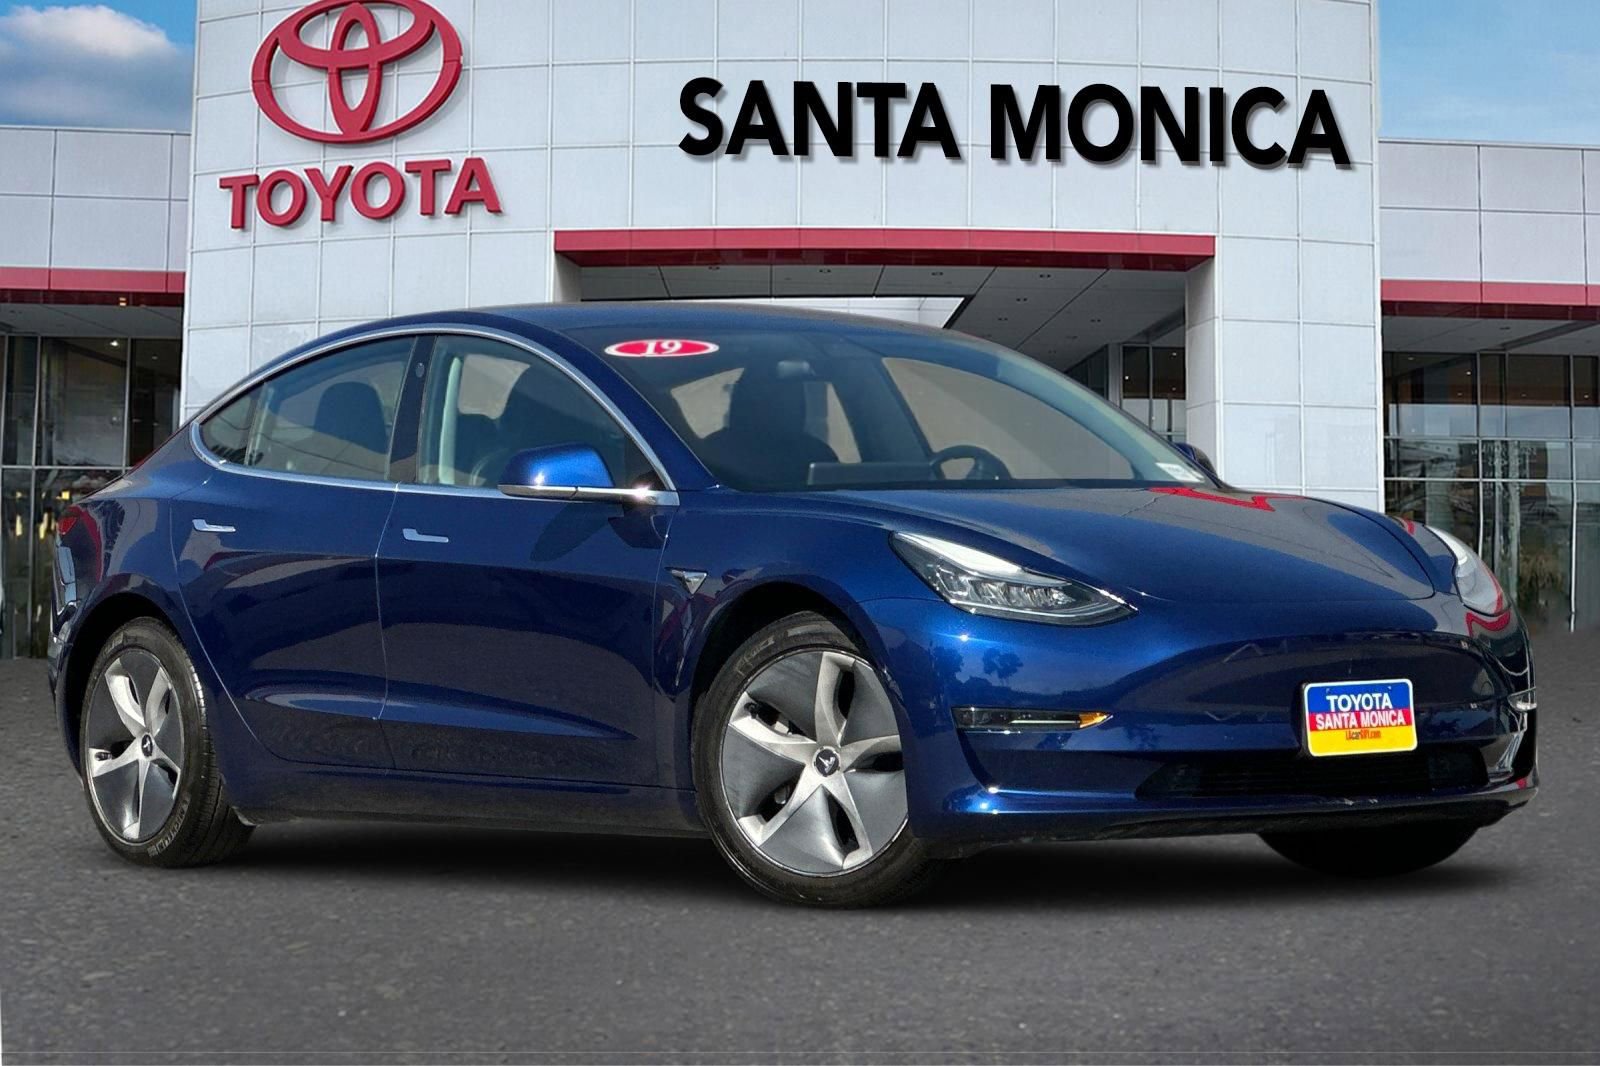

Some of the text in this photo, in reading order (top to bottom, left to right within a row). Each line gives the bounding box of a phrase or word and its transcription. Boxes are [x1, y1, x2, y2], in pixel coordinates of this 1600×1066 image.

[678, 77, 1351, 167] SANTA MONICA
[219, 157, 502, 229] TOYOTA
[640, 340, 682, 357] 19
[1326, 693, 1393, 712] TOYOTA
[1315, 709, 1406, 730] SANTA MONICA
